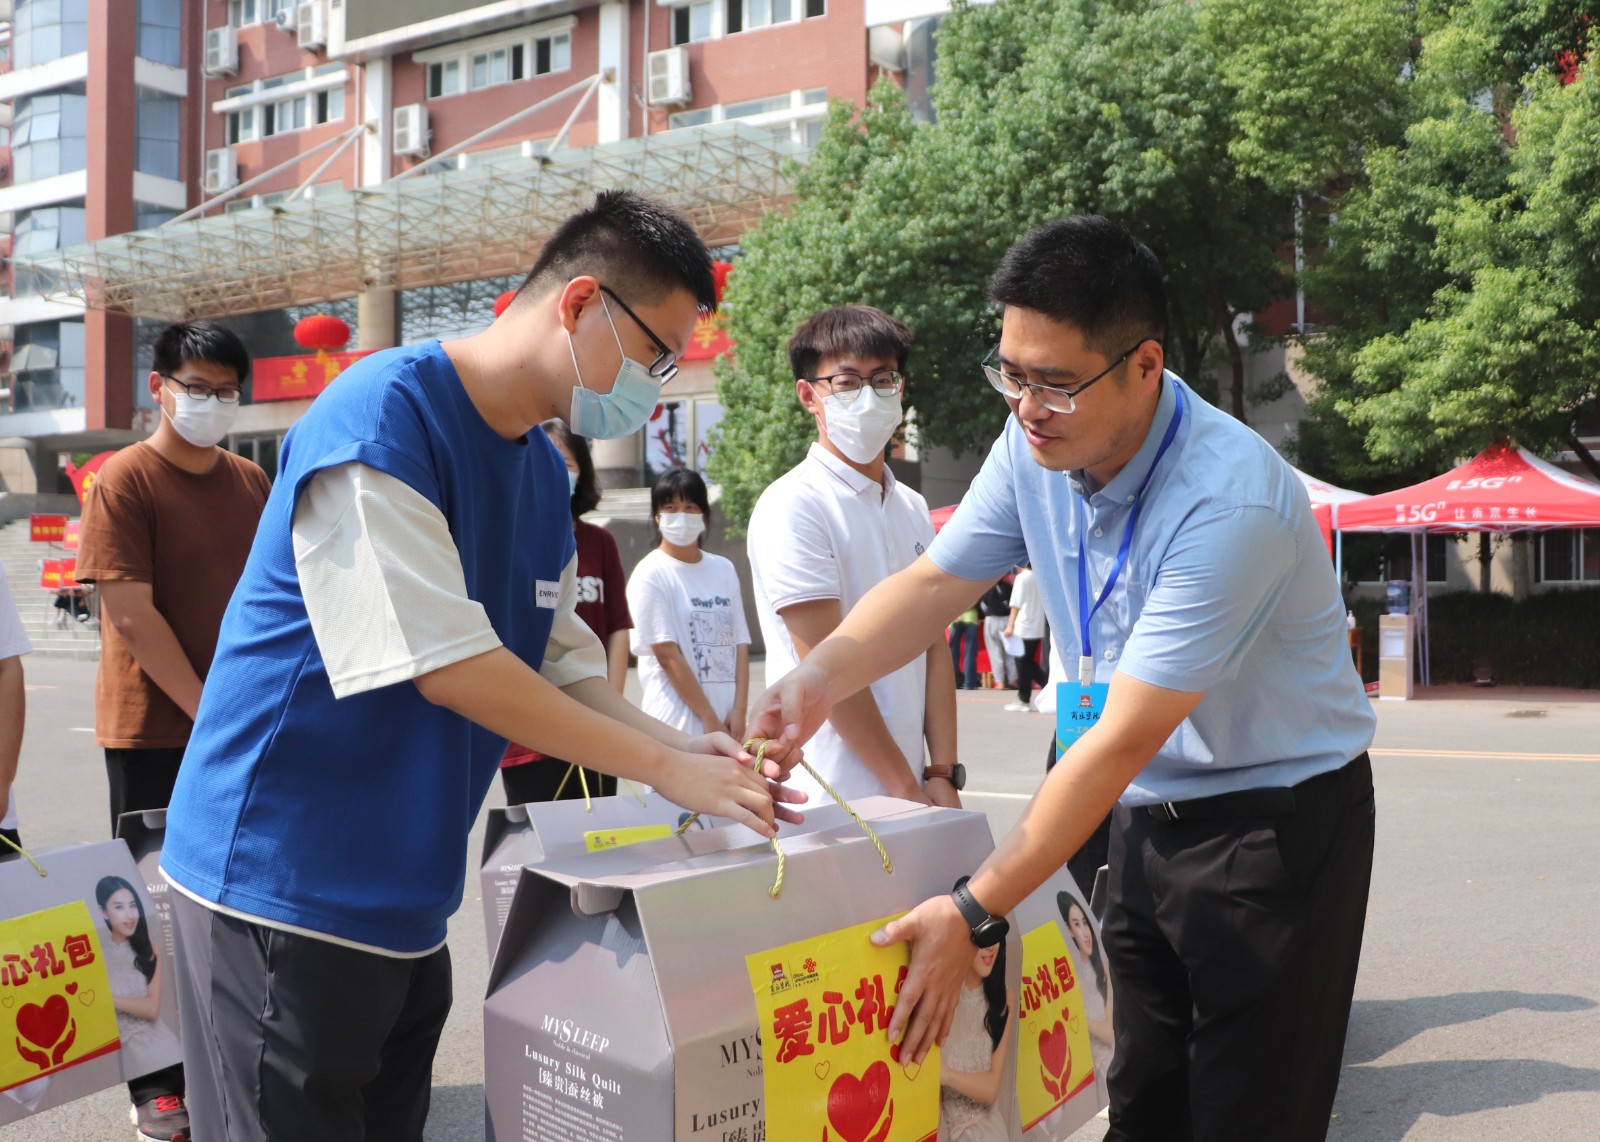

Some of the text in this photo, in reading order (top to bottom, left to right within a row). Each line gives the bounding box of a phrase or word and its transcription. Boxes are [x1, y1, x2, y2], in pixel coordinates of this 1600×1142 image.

[1, 933, 95, 987] 心礼包
[1019, 955, 1075, 1018] 心礼包
[541, 1014, 610, 1053] MYSLEEP
[773, 965, 908, 1064] 爱心礼
[525, 1044, 621, 1095] Lusury Silk Quilt
[691, 1099, 761, 1133] Lusury
